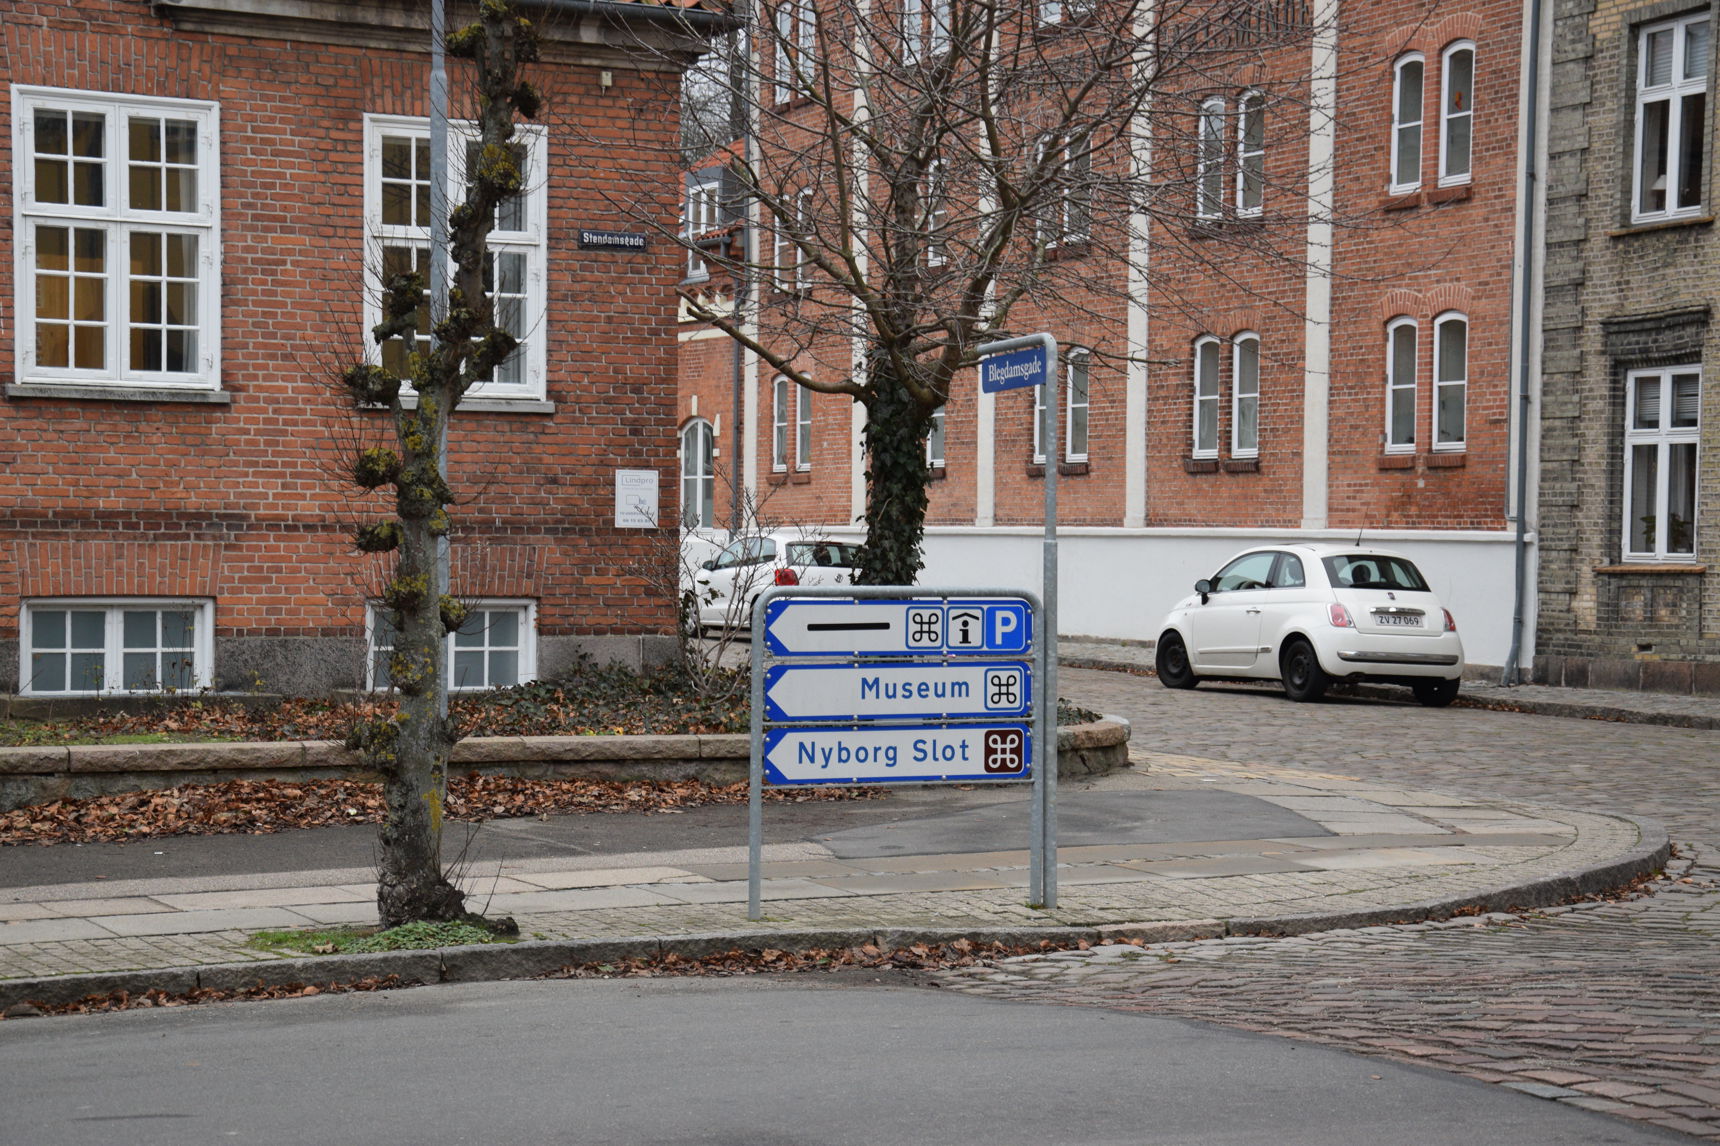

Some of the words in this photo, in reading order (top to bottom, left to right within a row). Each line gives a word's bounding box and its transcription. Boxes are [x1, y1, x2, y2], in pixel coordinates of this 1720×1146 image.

[583, 232, 644, 246] Stendamsgade
[988, 355, 1042, 384] Blegdamsgade
[995, 610, 1018, 645] P
[1379, 615, 1390, 624] ZV
[1392, 616, 1402, 625] 27
[1403, 616, 1419, 626] 069
[860, 677, 970, 700] Museum
[798, 741, 898, 769] Nyborg
[912, 739, 969, 762] Slot
